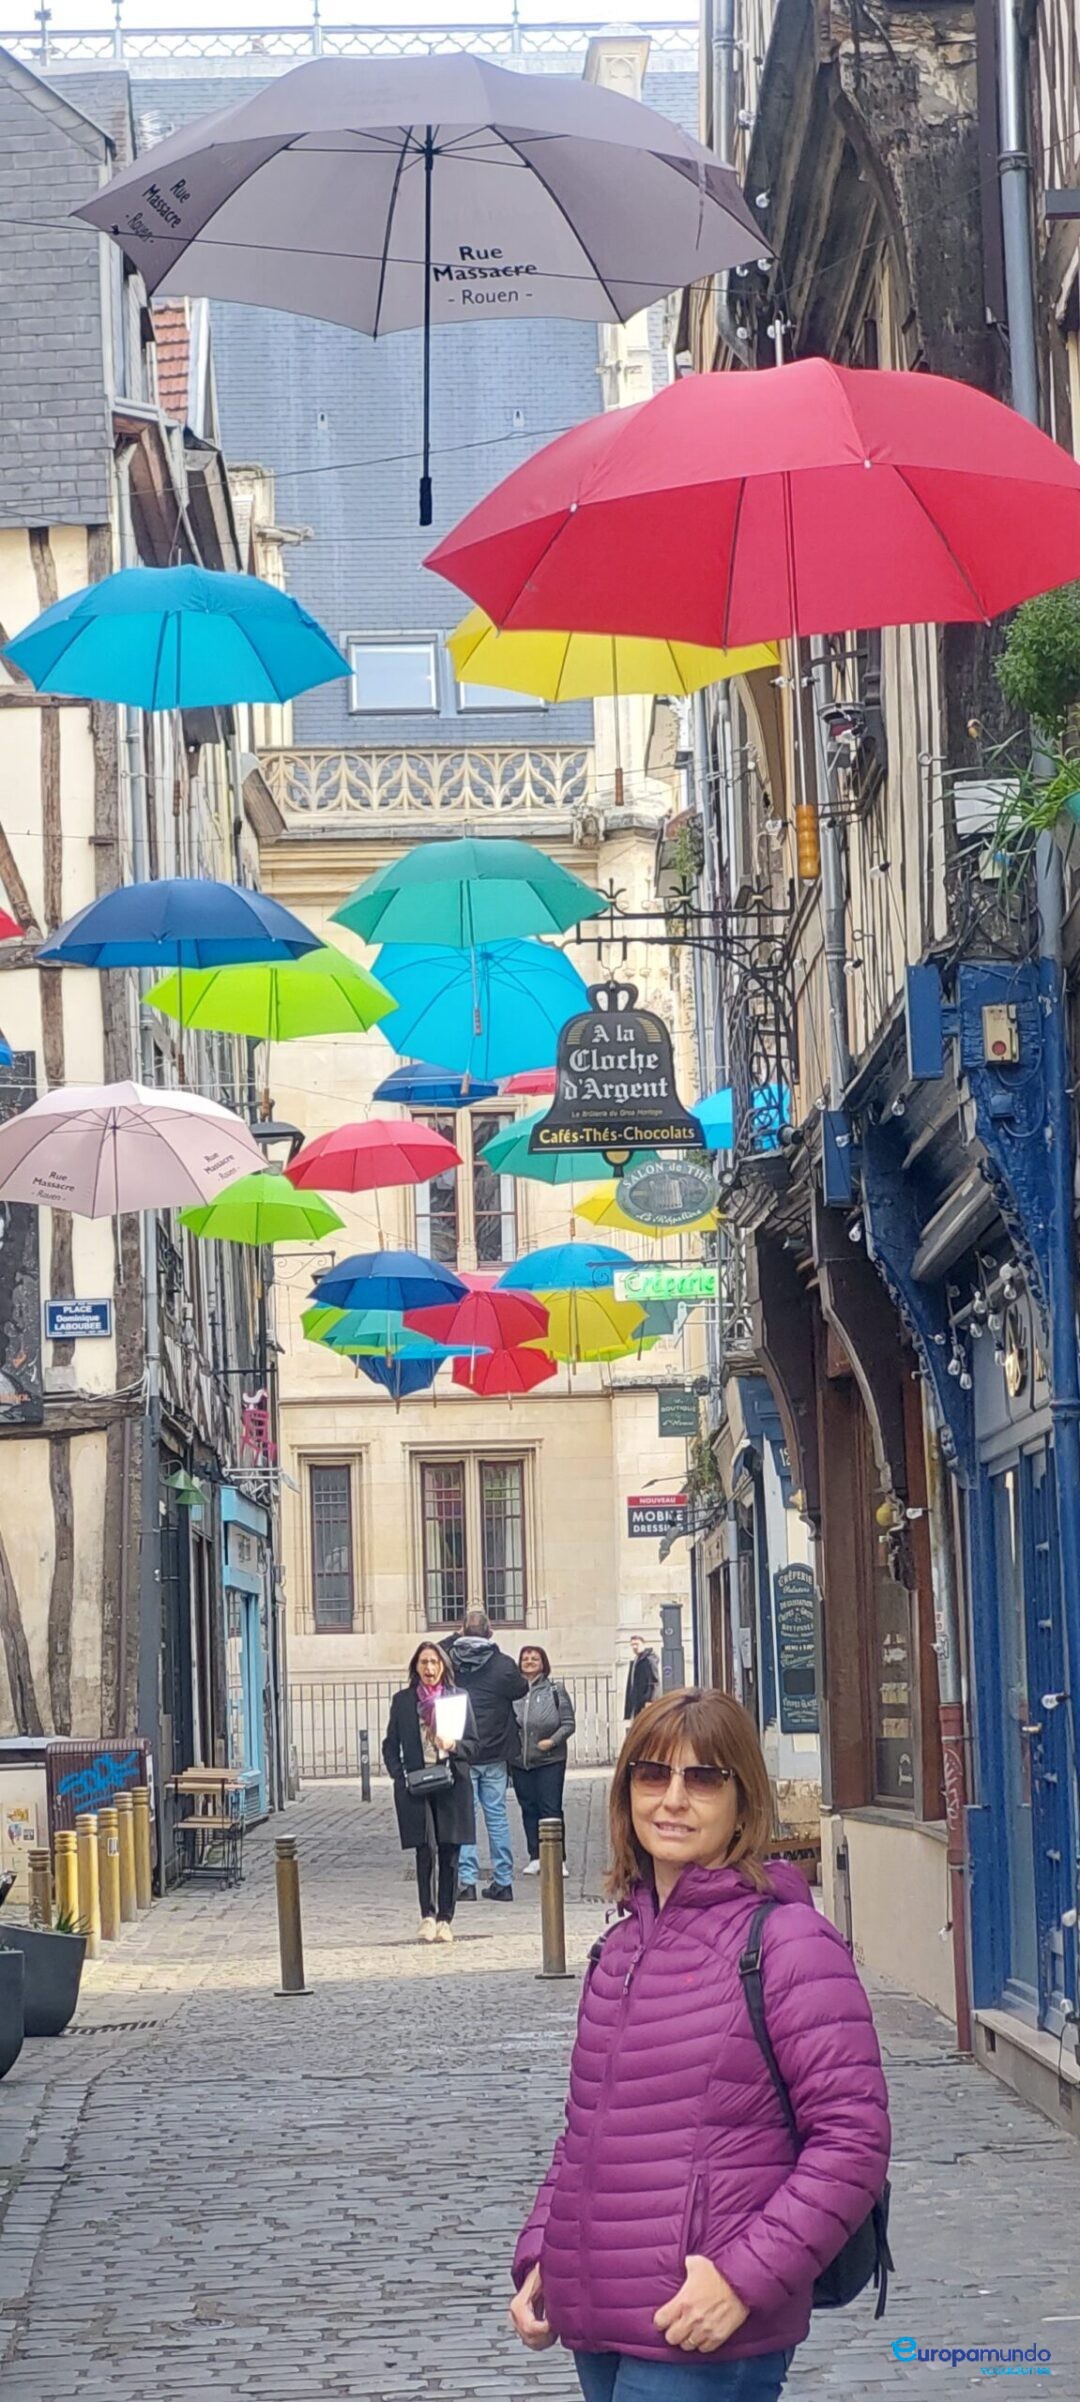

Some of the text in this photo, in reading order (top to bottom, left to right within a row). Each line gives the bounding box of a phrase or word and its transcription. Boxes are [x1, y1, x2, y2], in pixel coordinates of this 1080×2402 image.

[169, 179, 191, 204] Rue
[141, 183, 182, 229] Massacre
[459, 246, 503, 261] Rue
[432, 264, 537, 282] Massacre
[461, 289, 519, 304] Rouen
[592, 1024, 635, 1043] A la
[569, 1048, 659, 1075] Cloche
[563, 1077, 669, 1104] d'Argent
[539, 1125, 695, 1144] Cafés-Thés-Chocolats
[203, 1152, 219, 1163] Rue
[203, 1154, 235, 1174] Massacre
[32, 1177, 75, 1192] Massacre
[48, 1171, 68, 1181] Rue
[623, 1163, 665, 1189] SALON
[669, 1162, 682, 1172] de
[56, 1314, 100, 1323] Dominique
[63, 1305, 93, 1314] PLACE
[639, 1497, 676, 1505] NOUVEAU
